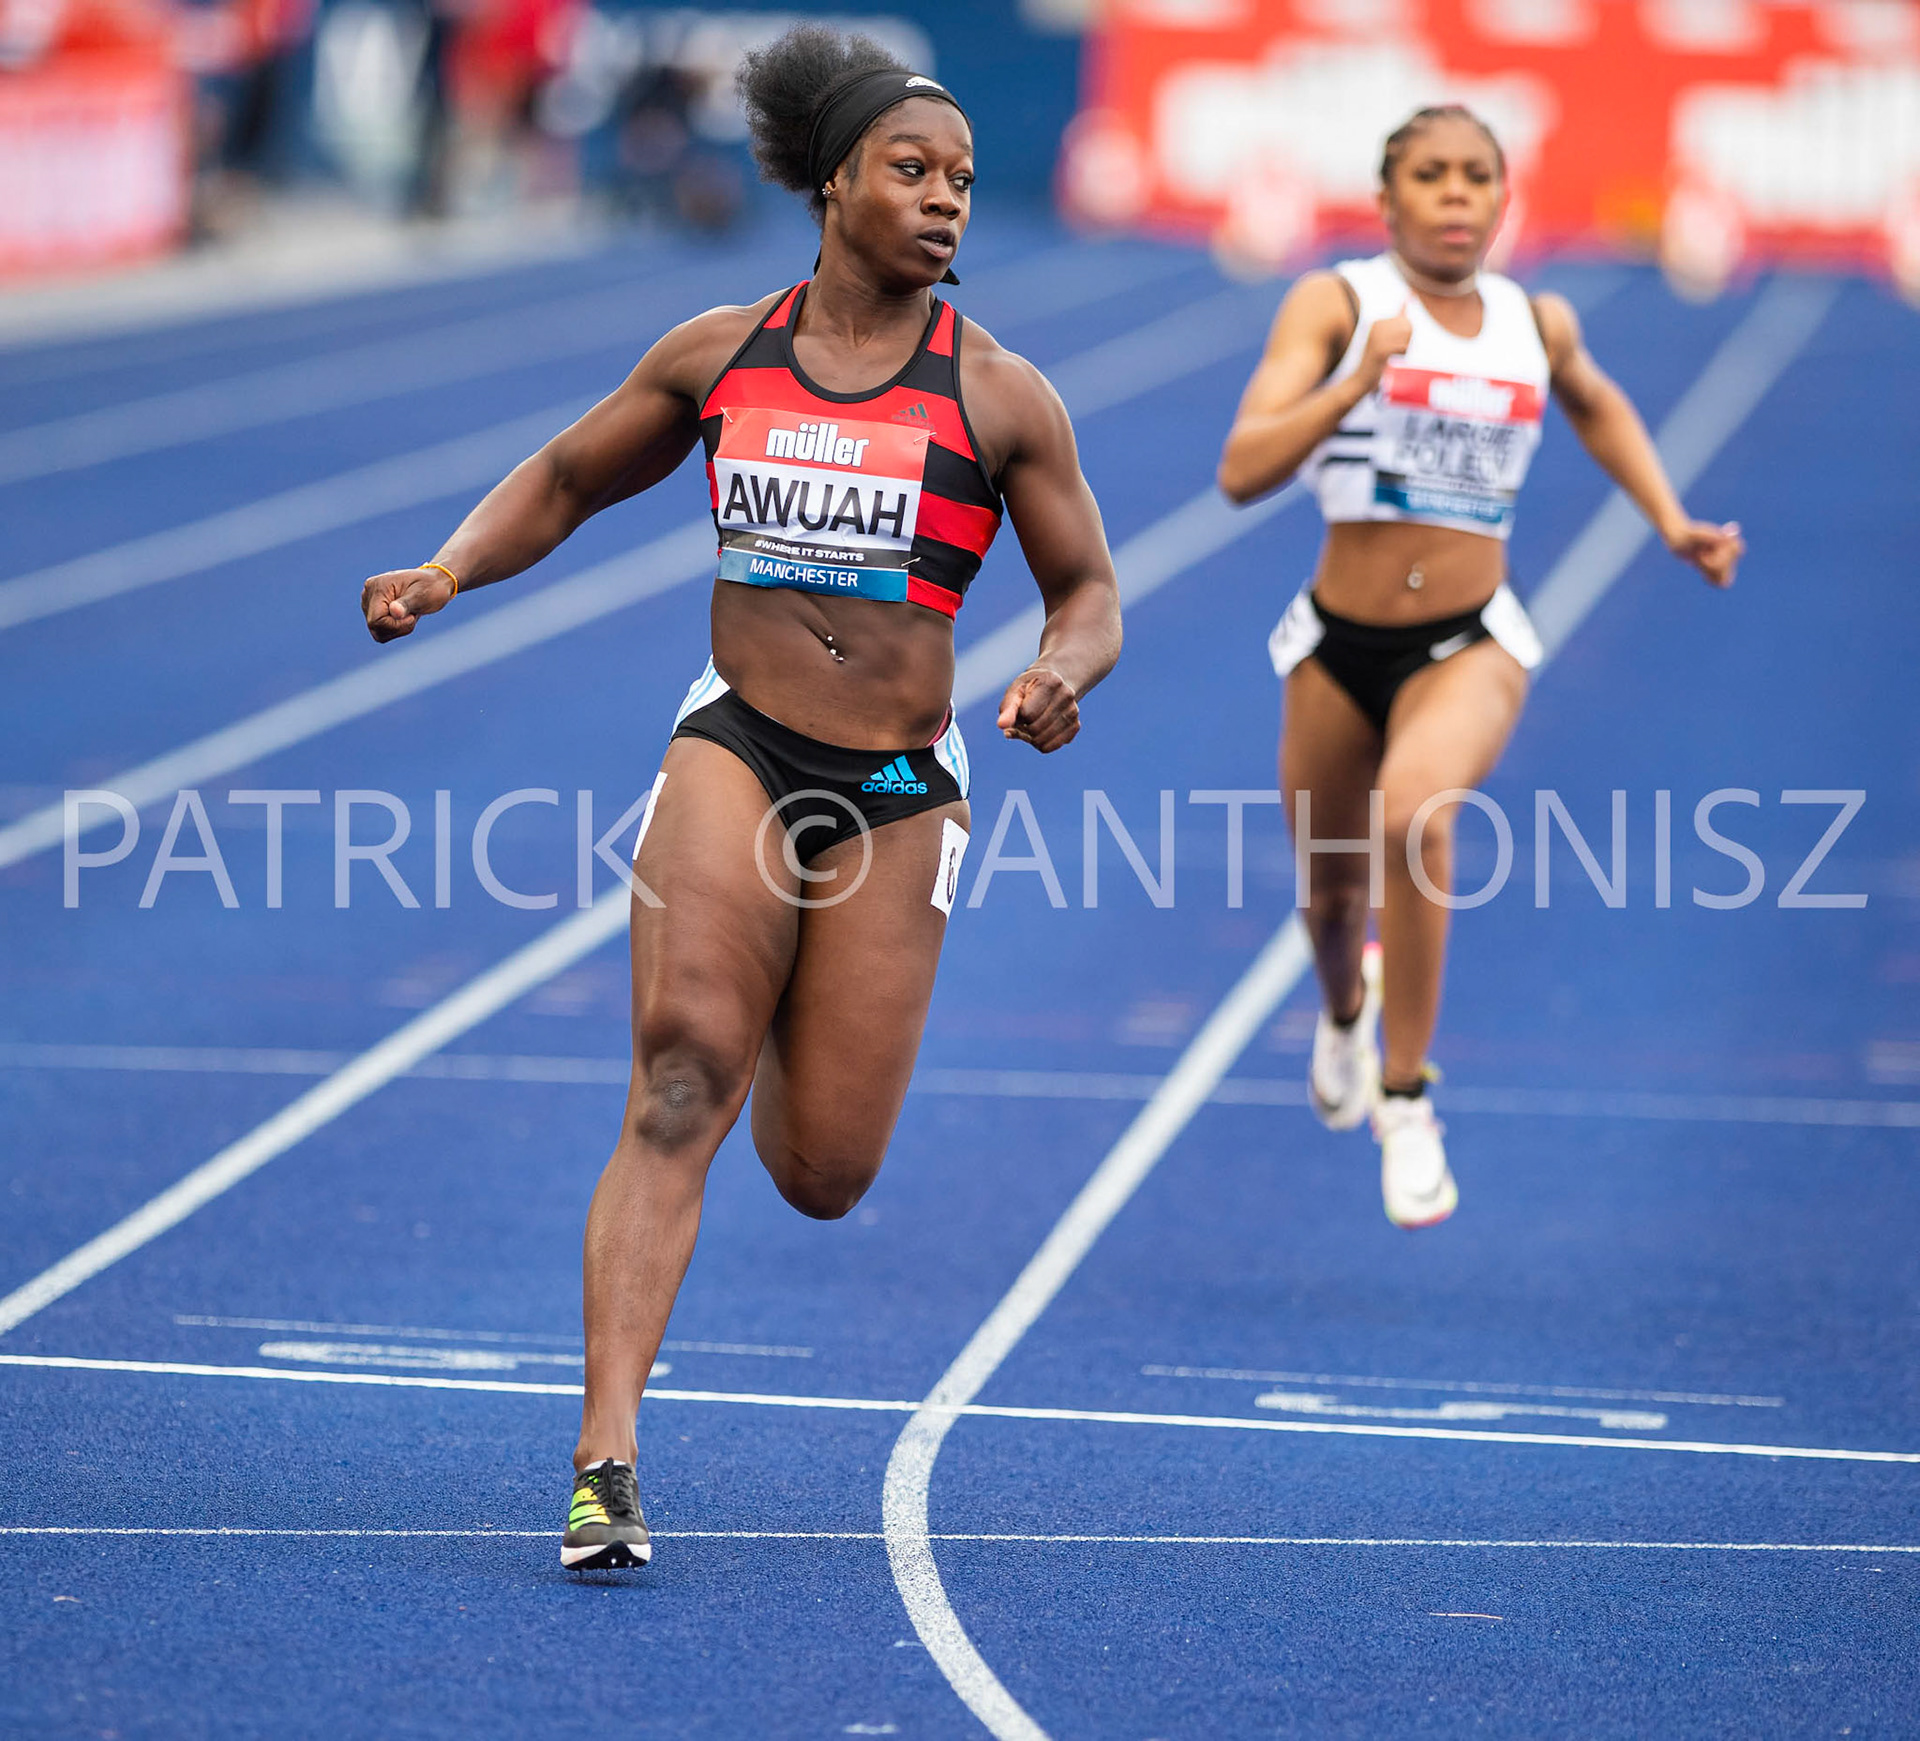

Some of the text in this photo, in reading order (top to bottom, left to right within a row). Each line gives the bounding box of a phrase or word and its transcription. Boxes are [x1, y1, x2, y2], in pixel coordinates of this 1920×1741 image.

[765, 422, 870, 467] müller
[723, 473, 907, 538] AWUAH
[754, 539, 865, 562] #WHERE IT STARTS
[749, 558, 858, 588] MANCHESTER
[861, 780, 928, 795] adidas
